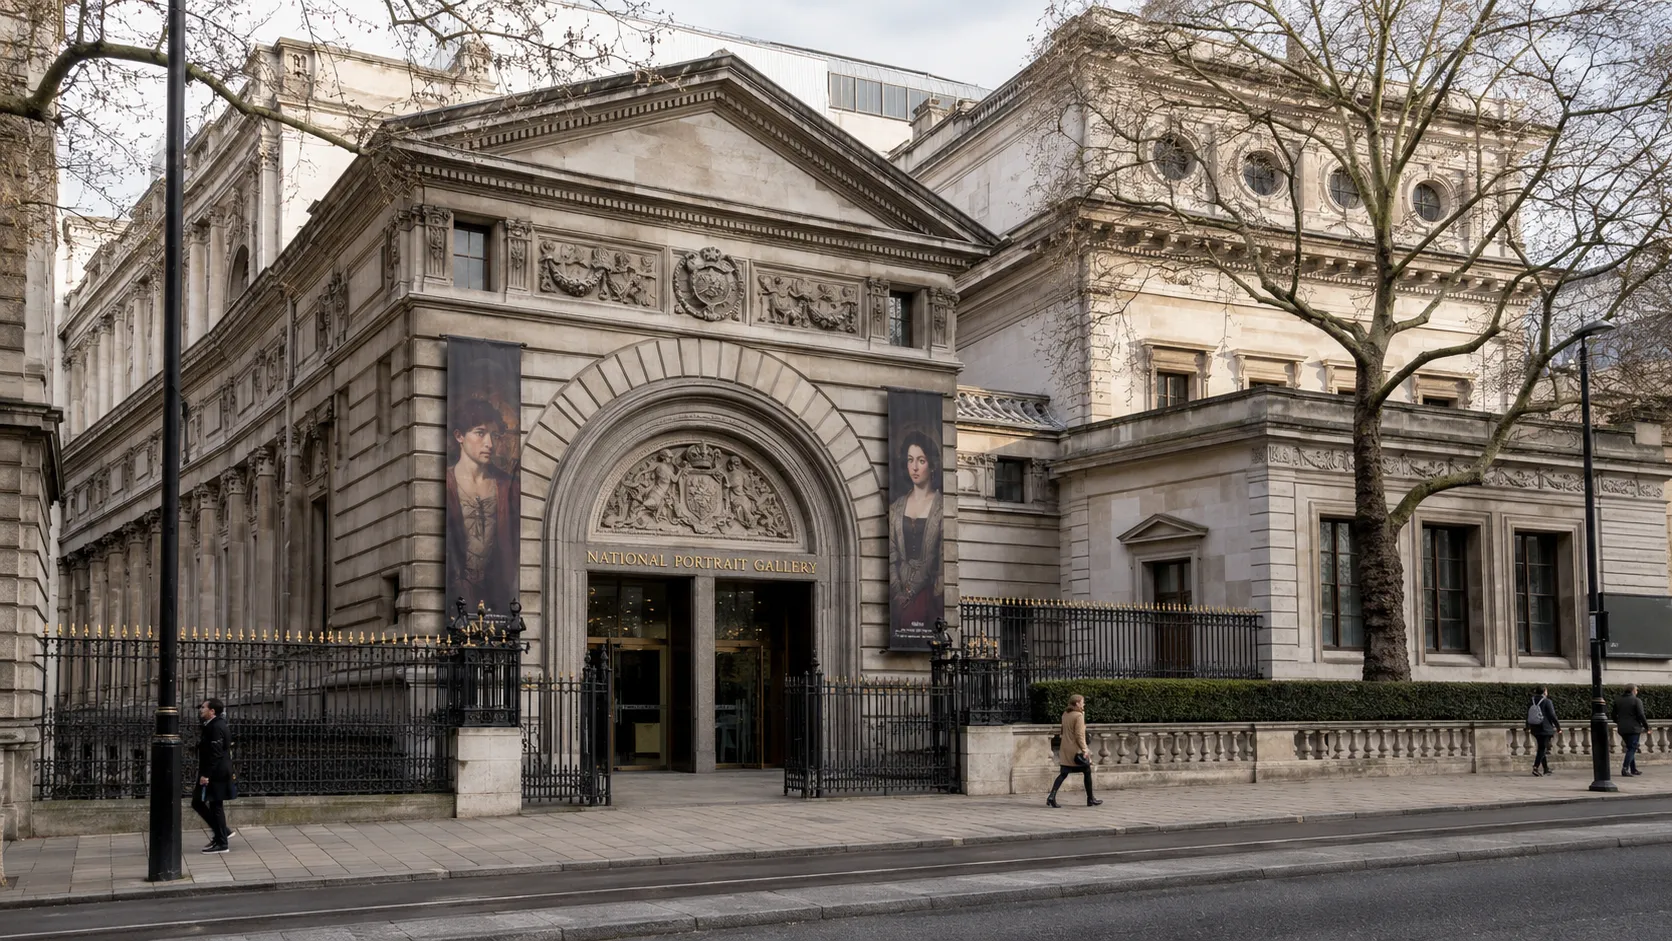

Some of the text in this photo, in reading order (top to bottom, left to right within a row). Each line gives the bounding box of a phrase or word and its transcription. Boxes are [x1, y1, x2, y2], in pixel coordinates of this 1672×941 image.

[587, 550, 817, 574] NATIONAL PORTRAIT GALLERY
